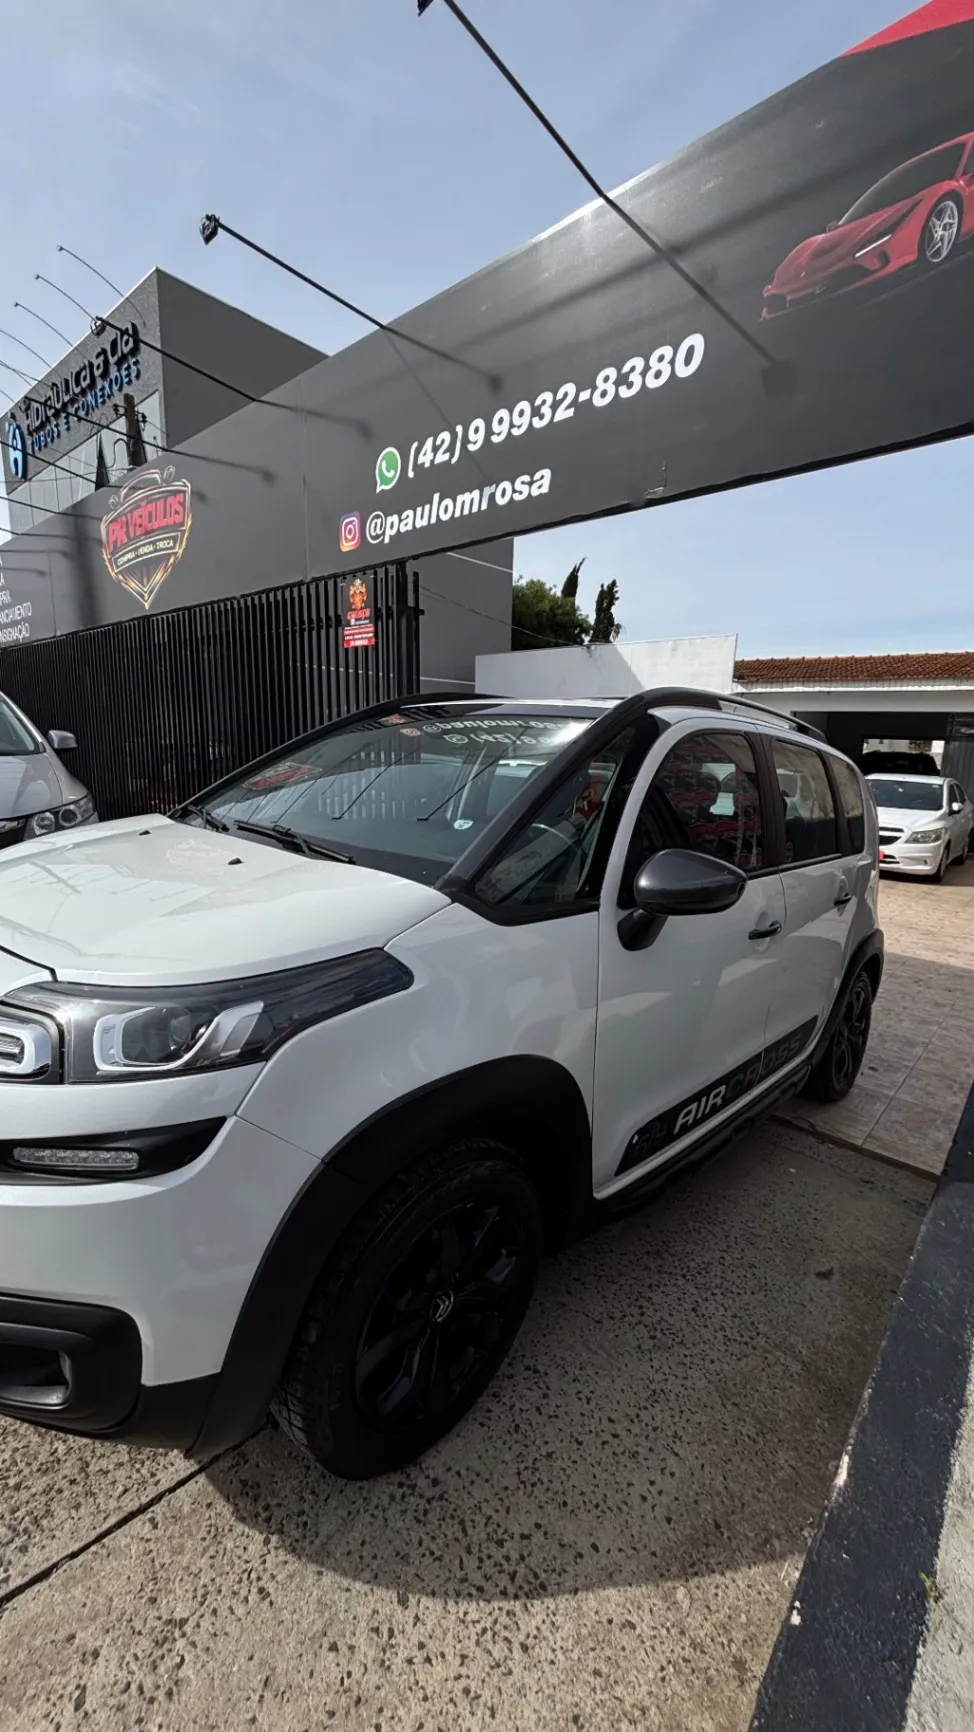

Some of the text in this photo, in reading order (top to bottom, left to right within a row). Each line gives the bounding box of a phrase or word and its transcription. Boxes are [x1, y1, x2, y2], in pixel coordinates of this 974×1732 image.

[407, 333, 705, 478] (42) 9 9932-8380
[108, 515, 128, 553] PR
[366, 468, 552, 544] @paulomrosa
[156, 539, 174, 550] TROCA
